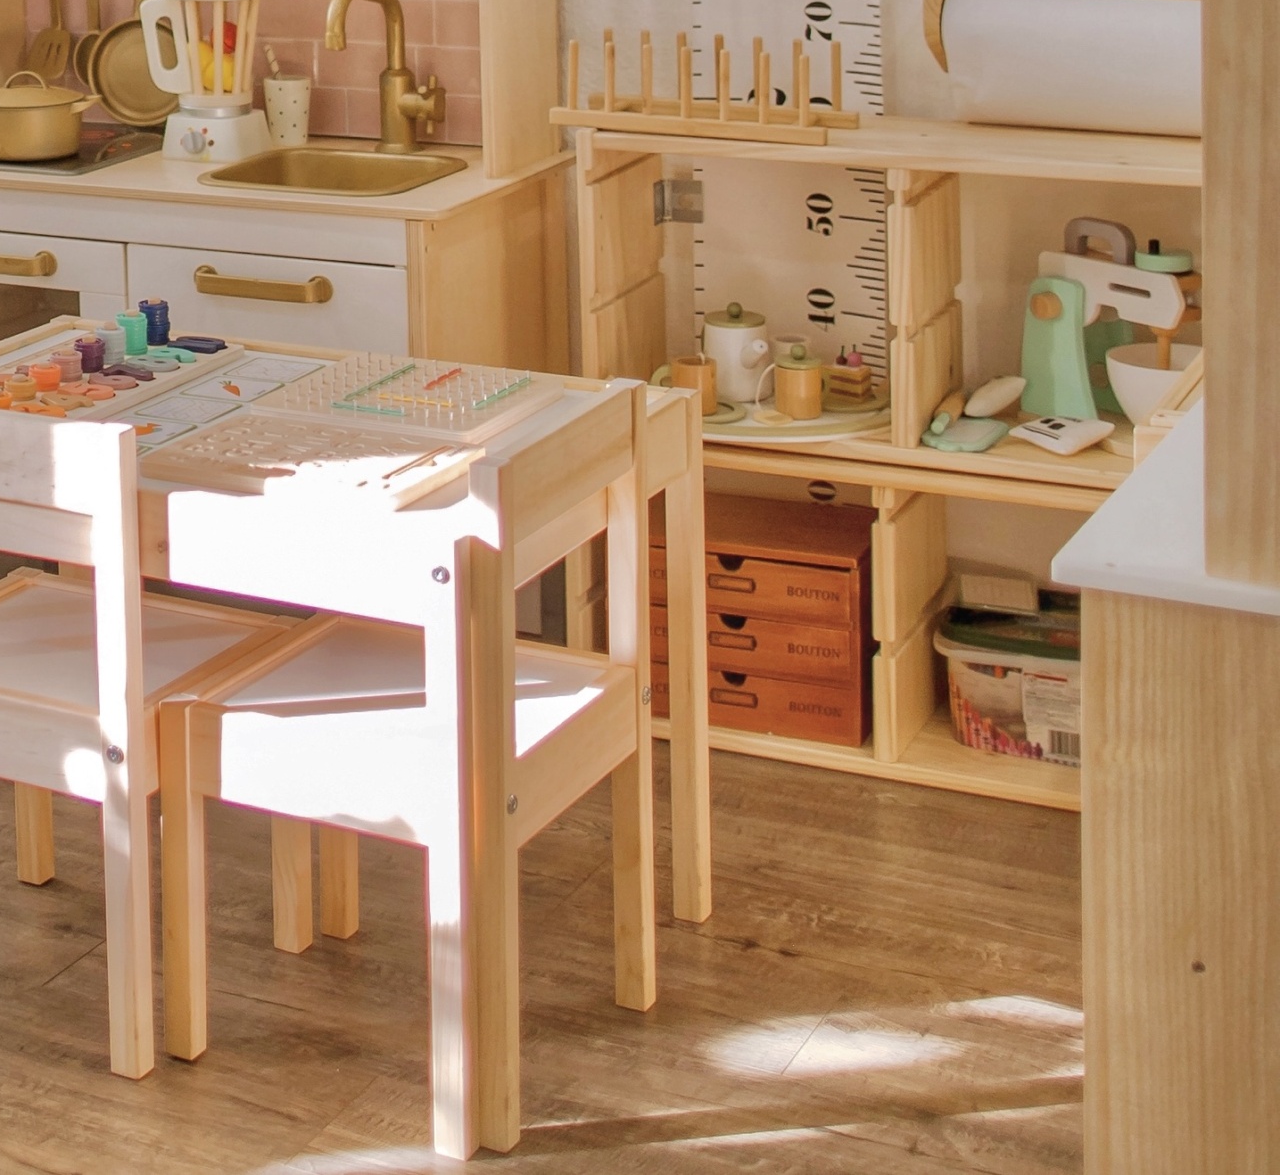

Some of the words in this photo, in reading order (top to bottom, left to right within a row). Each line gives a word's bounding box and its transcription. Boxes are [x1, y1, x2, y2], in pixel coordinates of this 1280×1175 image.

[804, 1, 833, 42] 70
[805, 192, 834, 237] 50
[807, 288, 835, 332] 40
[787, 586, 840, 602] BOUTON
[788, 643, 841, 658] BOUTON
[789, 701, 842, 717] BOUTON
